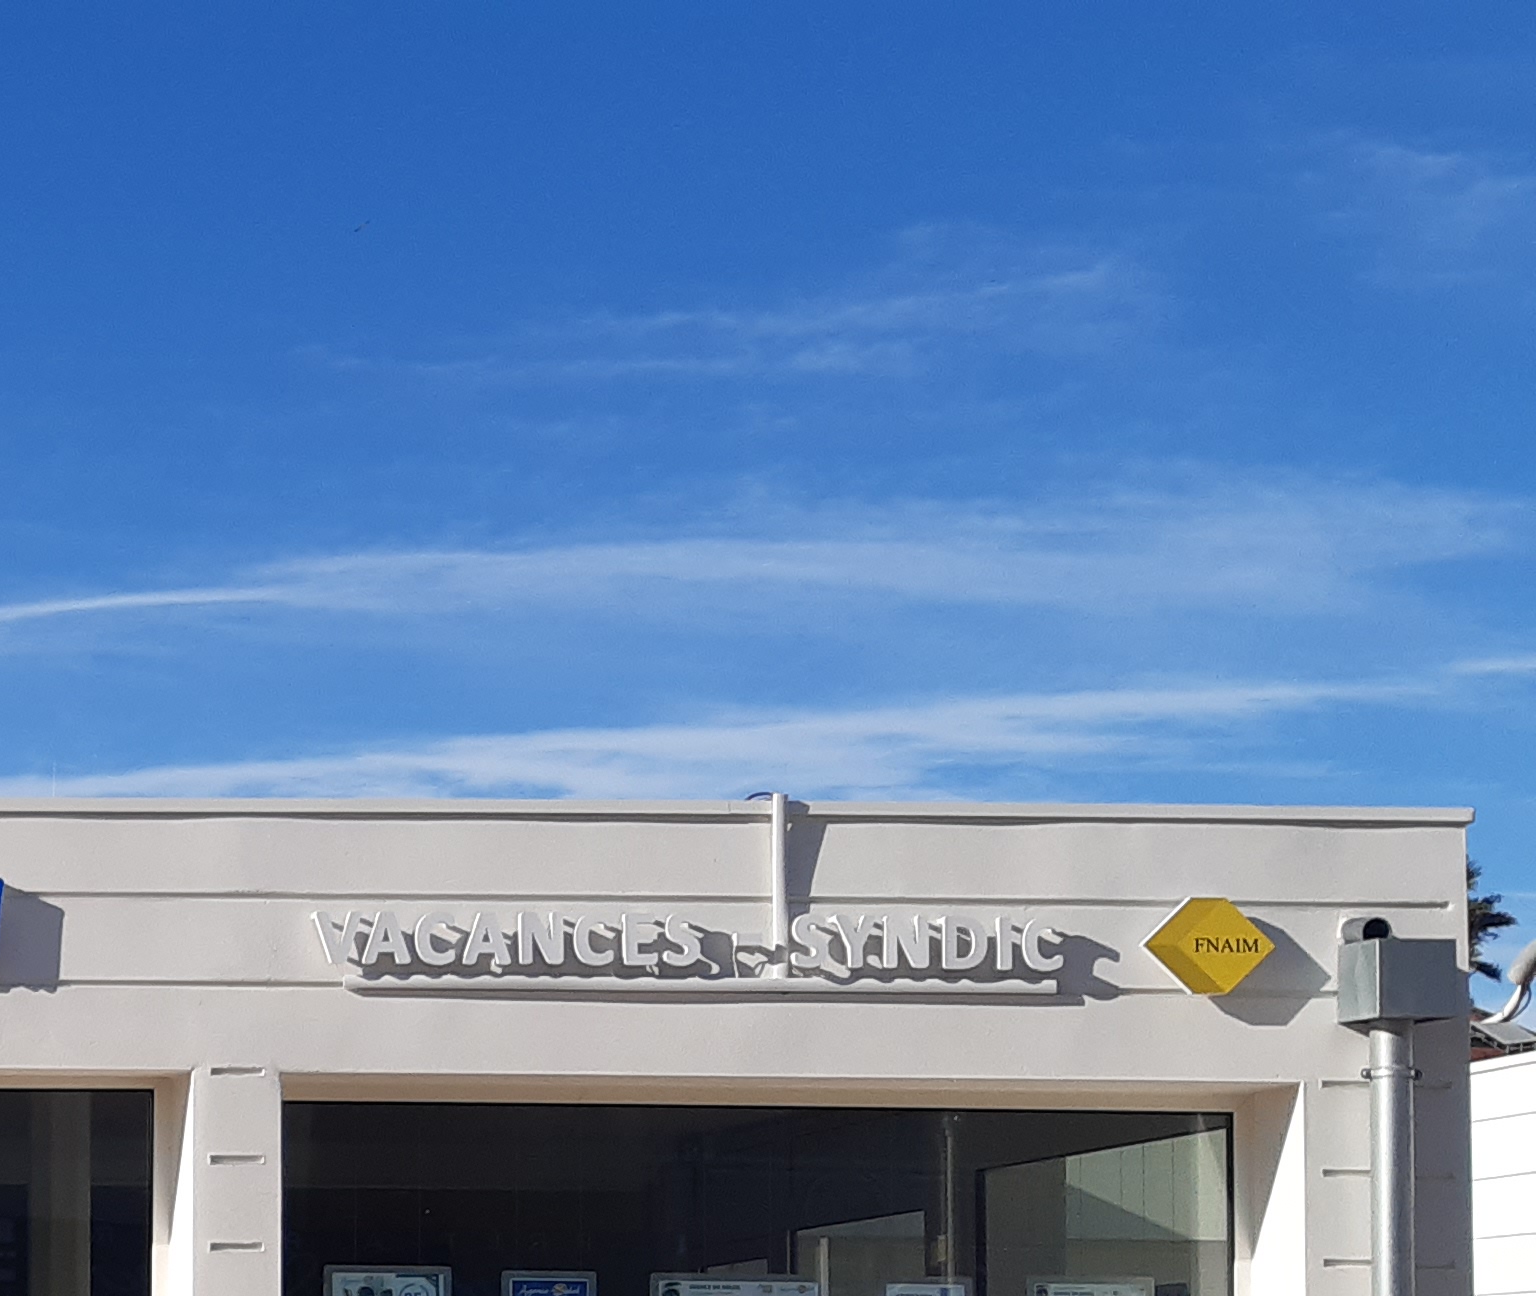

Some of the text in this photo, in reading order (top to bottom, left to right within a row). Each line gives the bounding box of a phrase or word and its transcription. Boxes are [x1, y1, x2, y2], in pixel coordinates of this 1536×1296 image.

[311, 907, 703, 972] VACANCES
[790, 912, 1067, 973] SYNDIC
[1193, 936, 1259, 954] FNAIM
